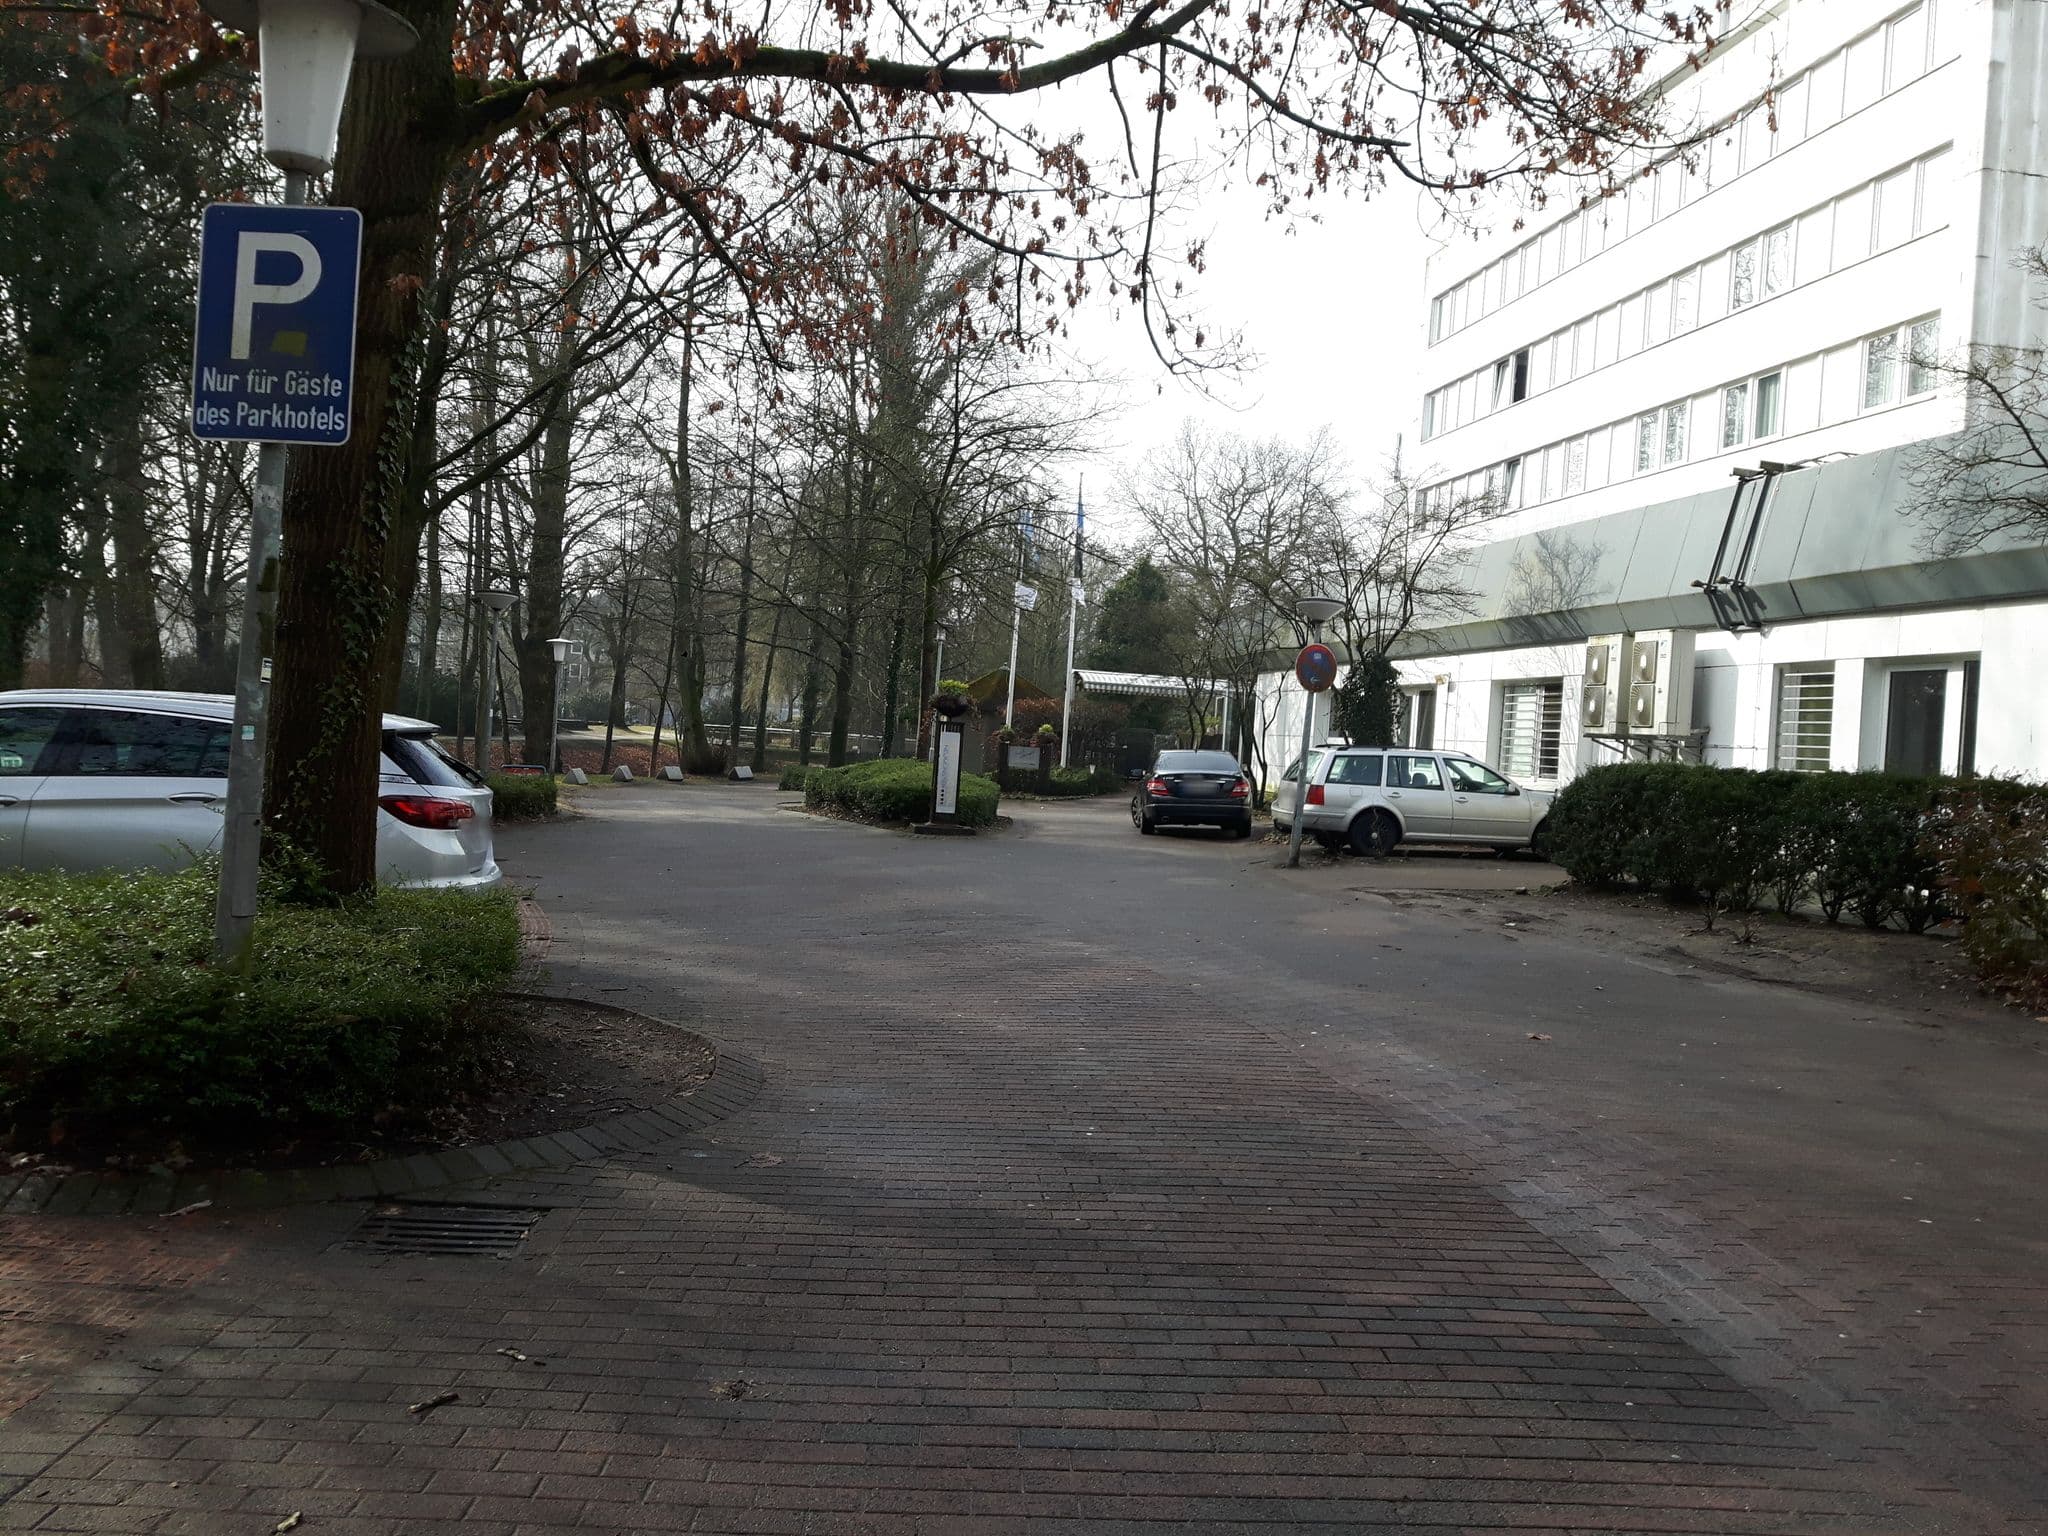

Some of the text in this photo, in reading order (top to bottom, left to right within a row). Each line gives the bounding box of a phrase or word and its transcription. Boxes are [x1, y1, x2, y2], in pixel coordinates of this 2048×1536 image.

[231, 231, 322, 360] P
[202, 367, 343, 397] Nur für Gäste
[196, 400, 345, 431] des Parkhotels
